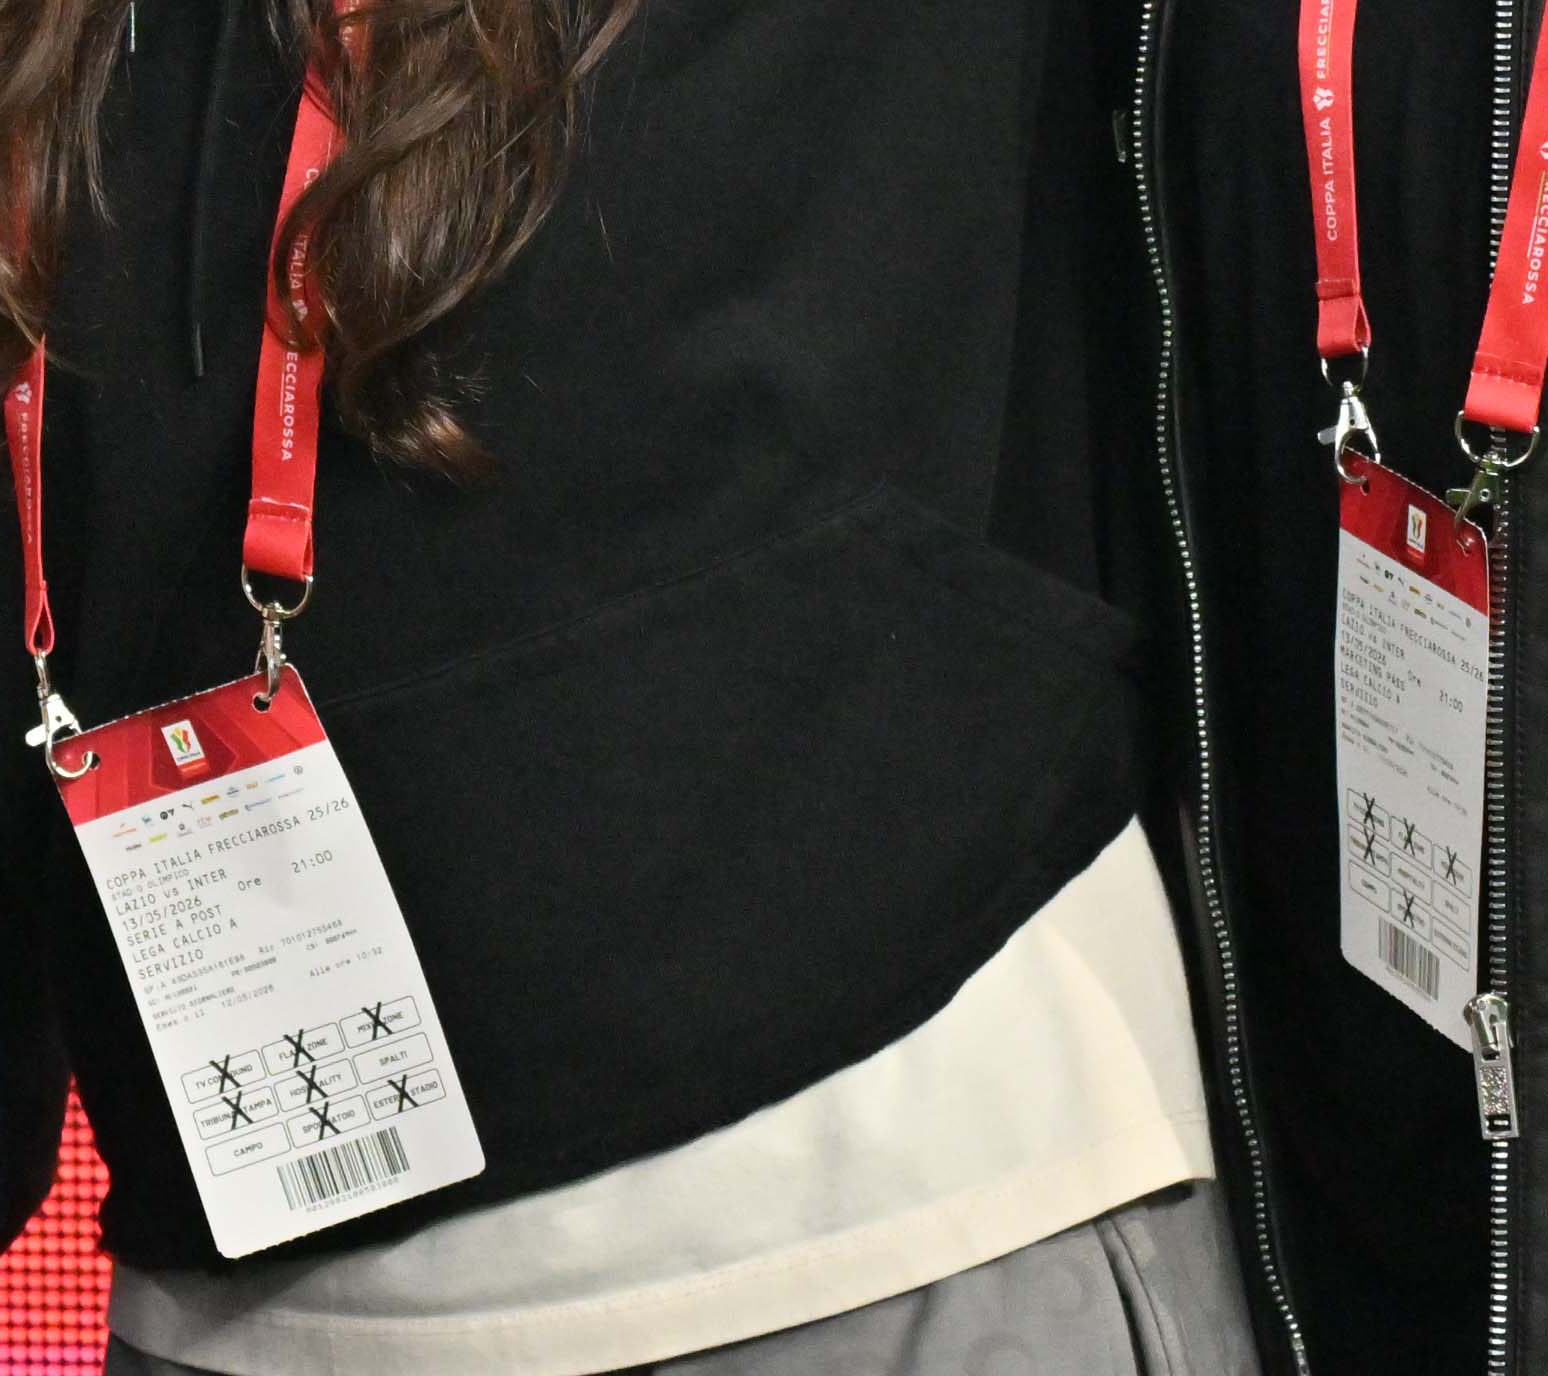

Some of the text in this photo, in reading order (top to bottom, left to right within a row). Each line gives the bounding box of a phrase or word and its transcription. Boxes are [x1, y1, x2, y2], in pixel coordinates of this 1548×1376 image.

[1319, 117, 1333, 175] ITALIA
[1326, 180, 1338, 241] COPPA
[281, 340, 298, 460] ECCIAROSSA
[105, 796, 350, 890] COPPA ITALIA FRECCIAROSSA 25/26
[115, 892, 157, 916] LAZIO
[187, 867, 227, 890] INTER
[236, 874, 262, 892] Ore
[291, 849, 334, 873] 21:00
[125, 924, 167, 947] SERIE
[190, 903, 223, 924] POST
[131, 942, 165, 963] LEGA
[171, 922, 222, 949] CALCIO
[136, 947, 205, 980] SERVIZIO
[241, 1097, 272, 1114] TAMPA
[232, 1141, 263, 1158] CAMPO
